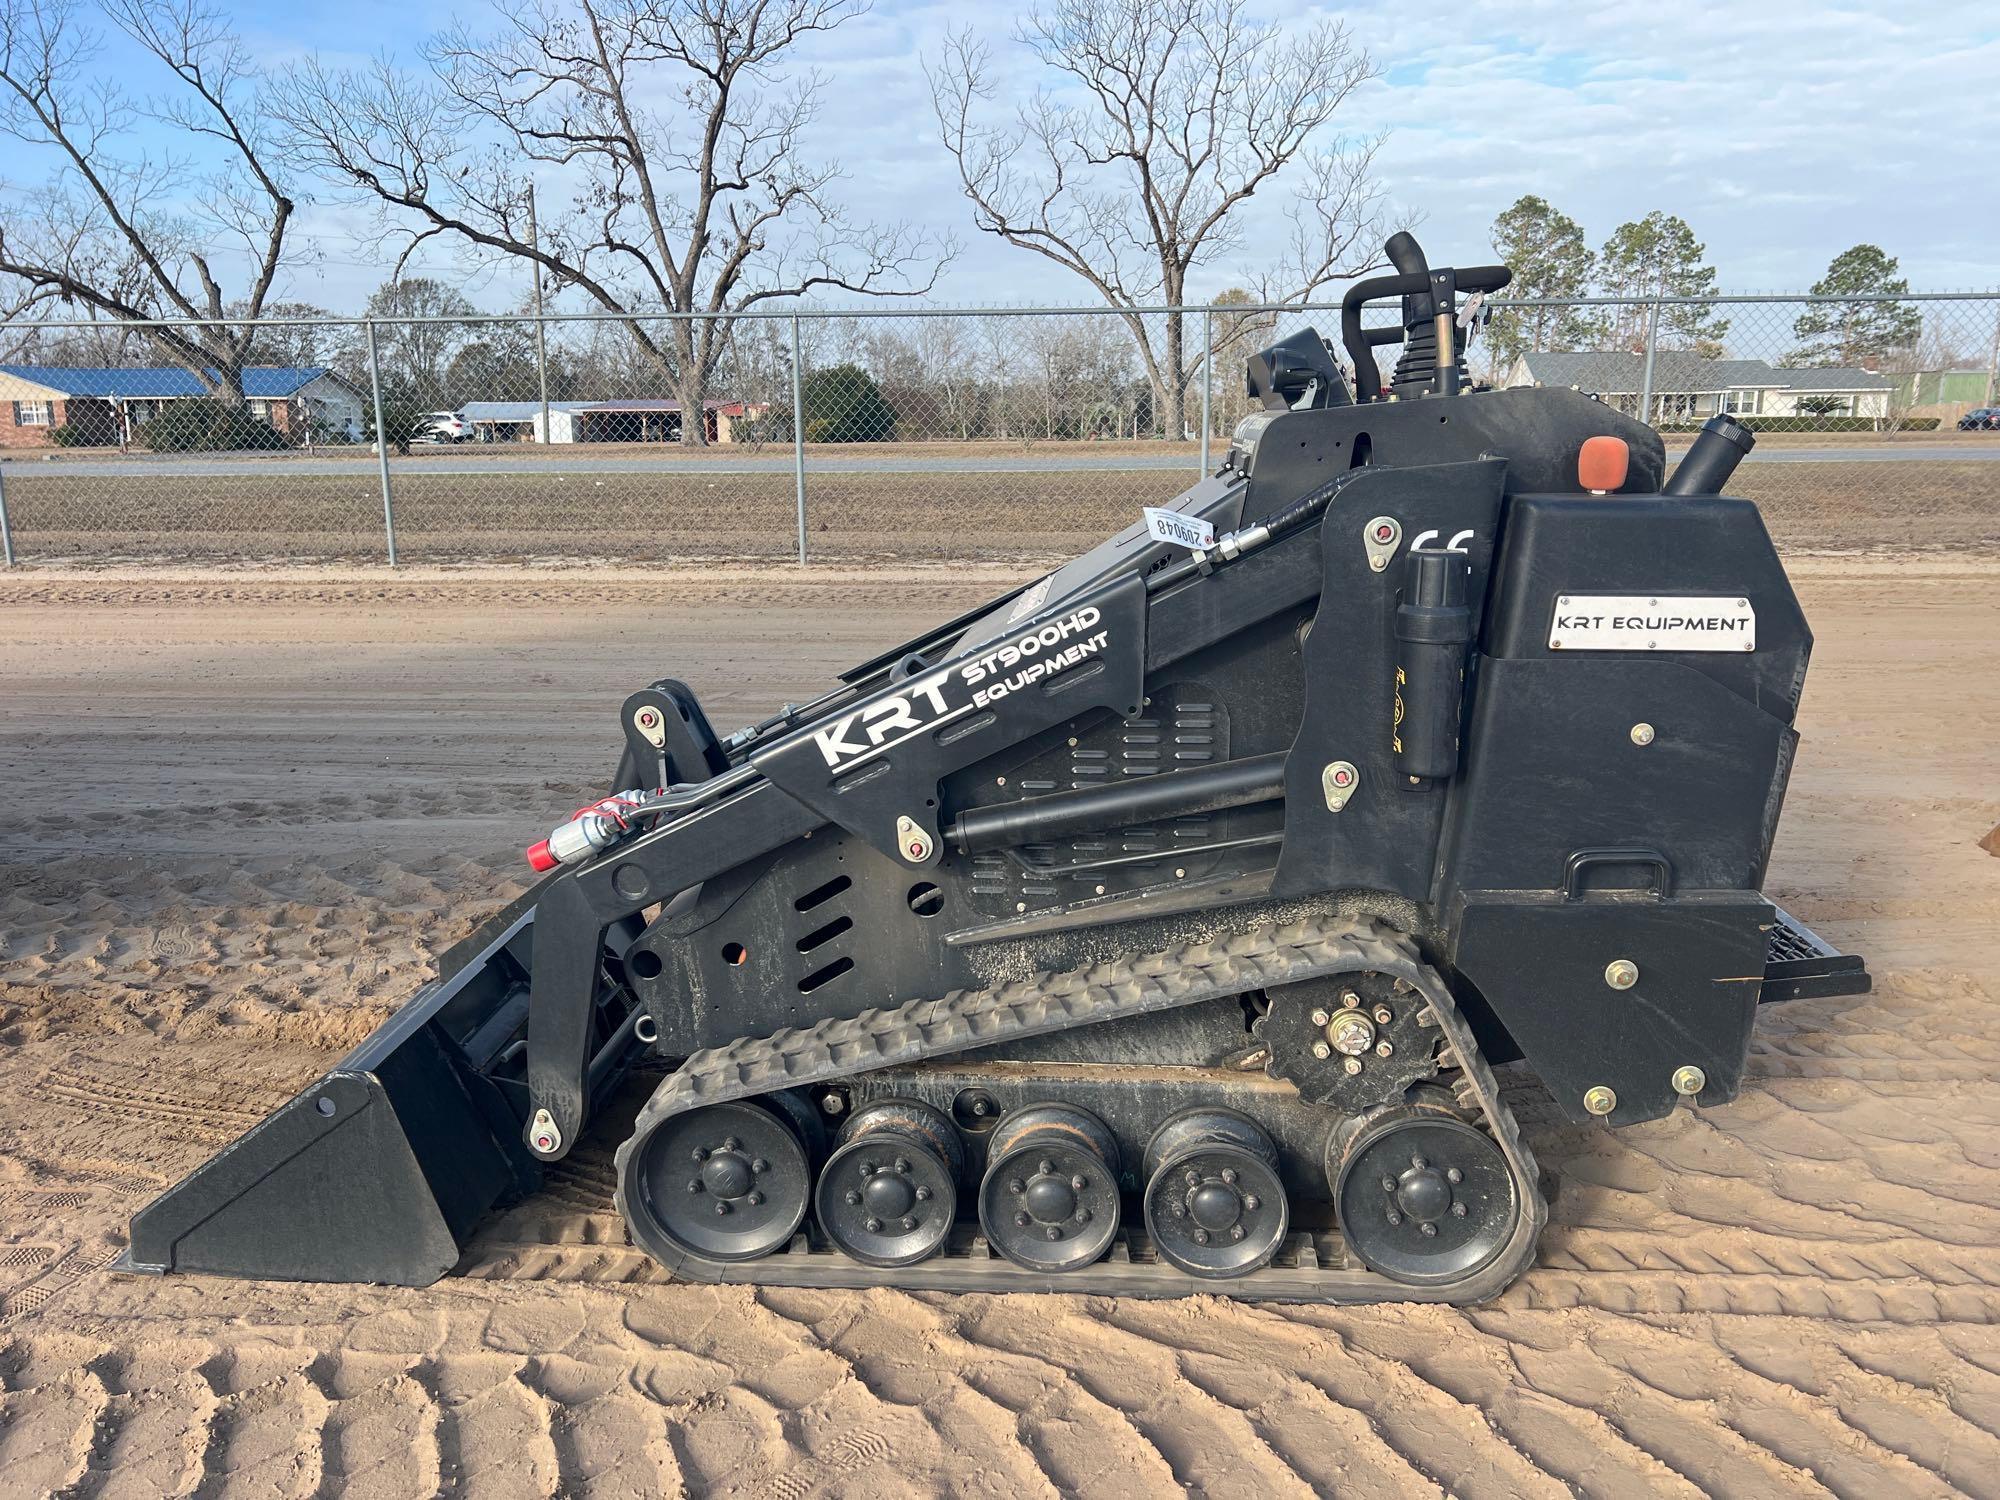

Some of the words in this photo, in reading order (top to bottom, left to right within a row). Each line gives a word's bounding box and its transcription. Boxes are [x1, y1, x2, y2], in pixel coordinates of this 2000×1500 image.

[1157, 519, 1202, 547] 209048
[961, 606, 1101, 686] ST900HD
[1557, 616, 1605, 630] KRT
[1612, 616, 1750, 631] EQUIPMENT
[972, 630, 1108, 709] EQUIPMENT
[813, 668, 951, 767] KRT
